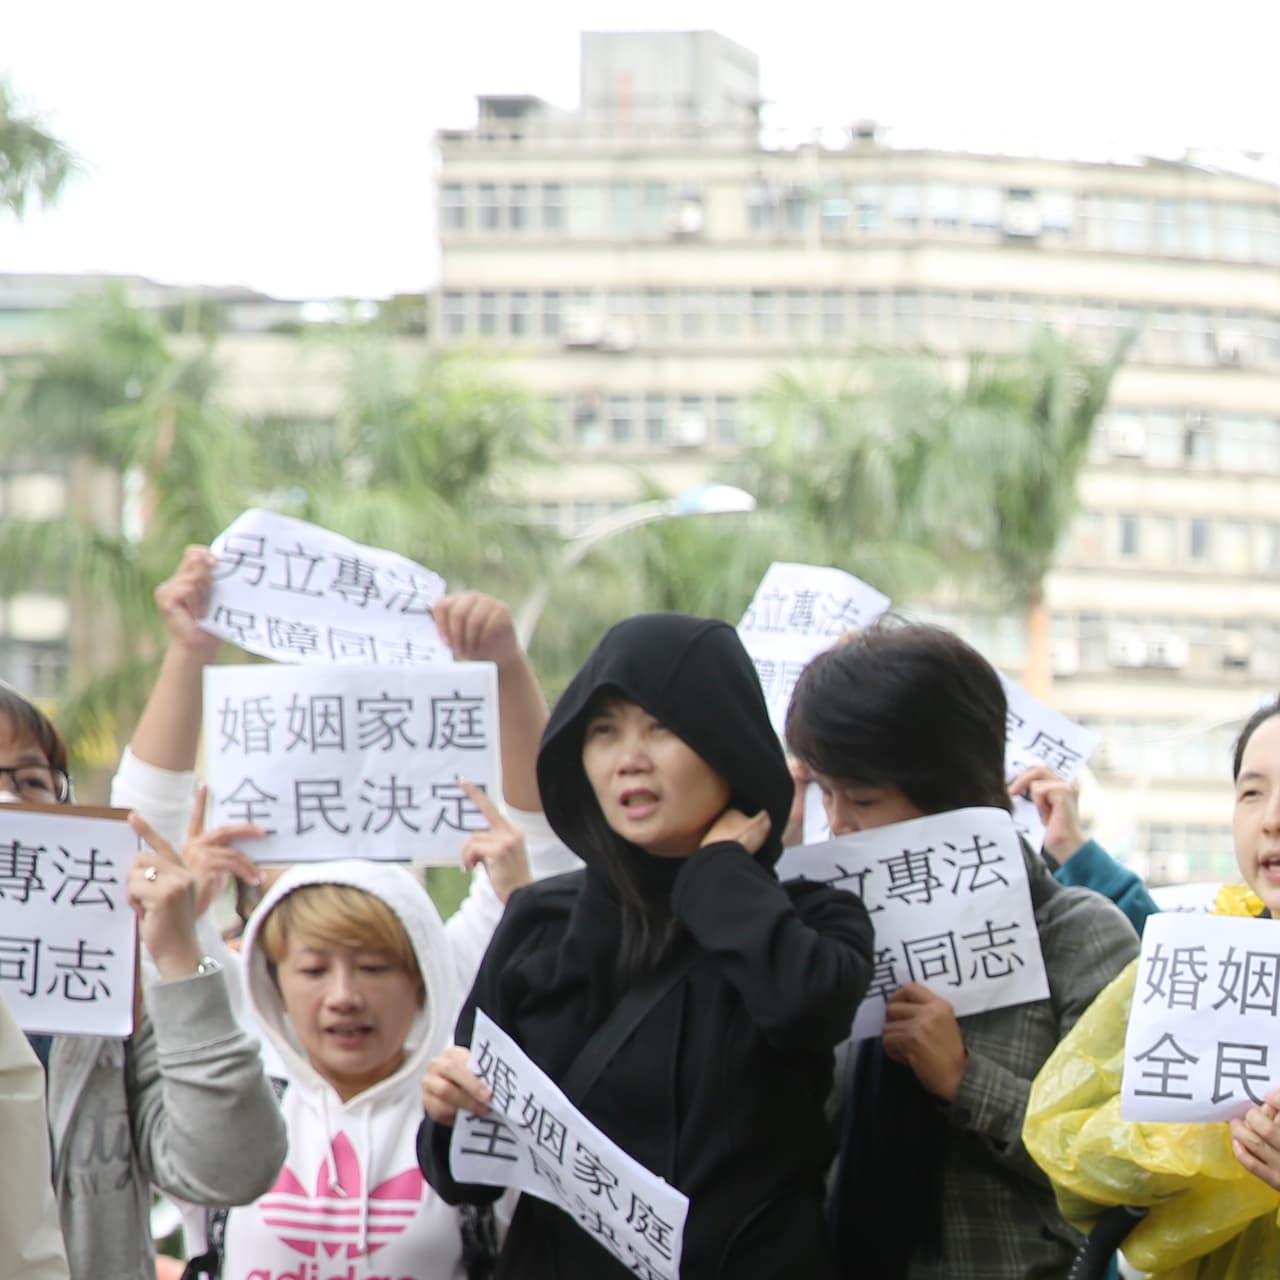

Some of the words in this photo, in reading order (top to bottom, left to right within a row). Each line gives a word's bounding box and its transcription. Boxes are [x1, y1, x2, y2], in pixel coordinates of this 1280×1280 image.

[214, 534, 435, 619] 另立專法
[217, 695, 488, 755] 婚姻家庭
[217, 777, 491, 838] 全民決定
[475, 1040, 675, 1261] 婚姻家庭
